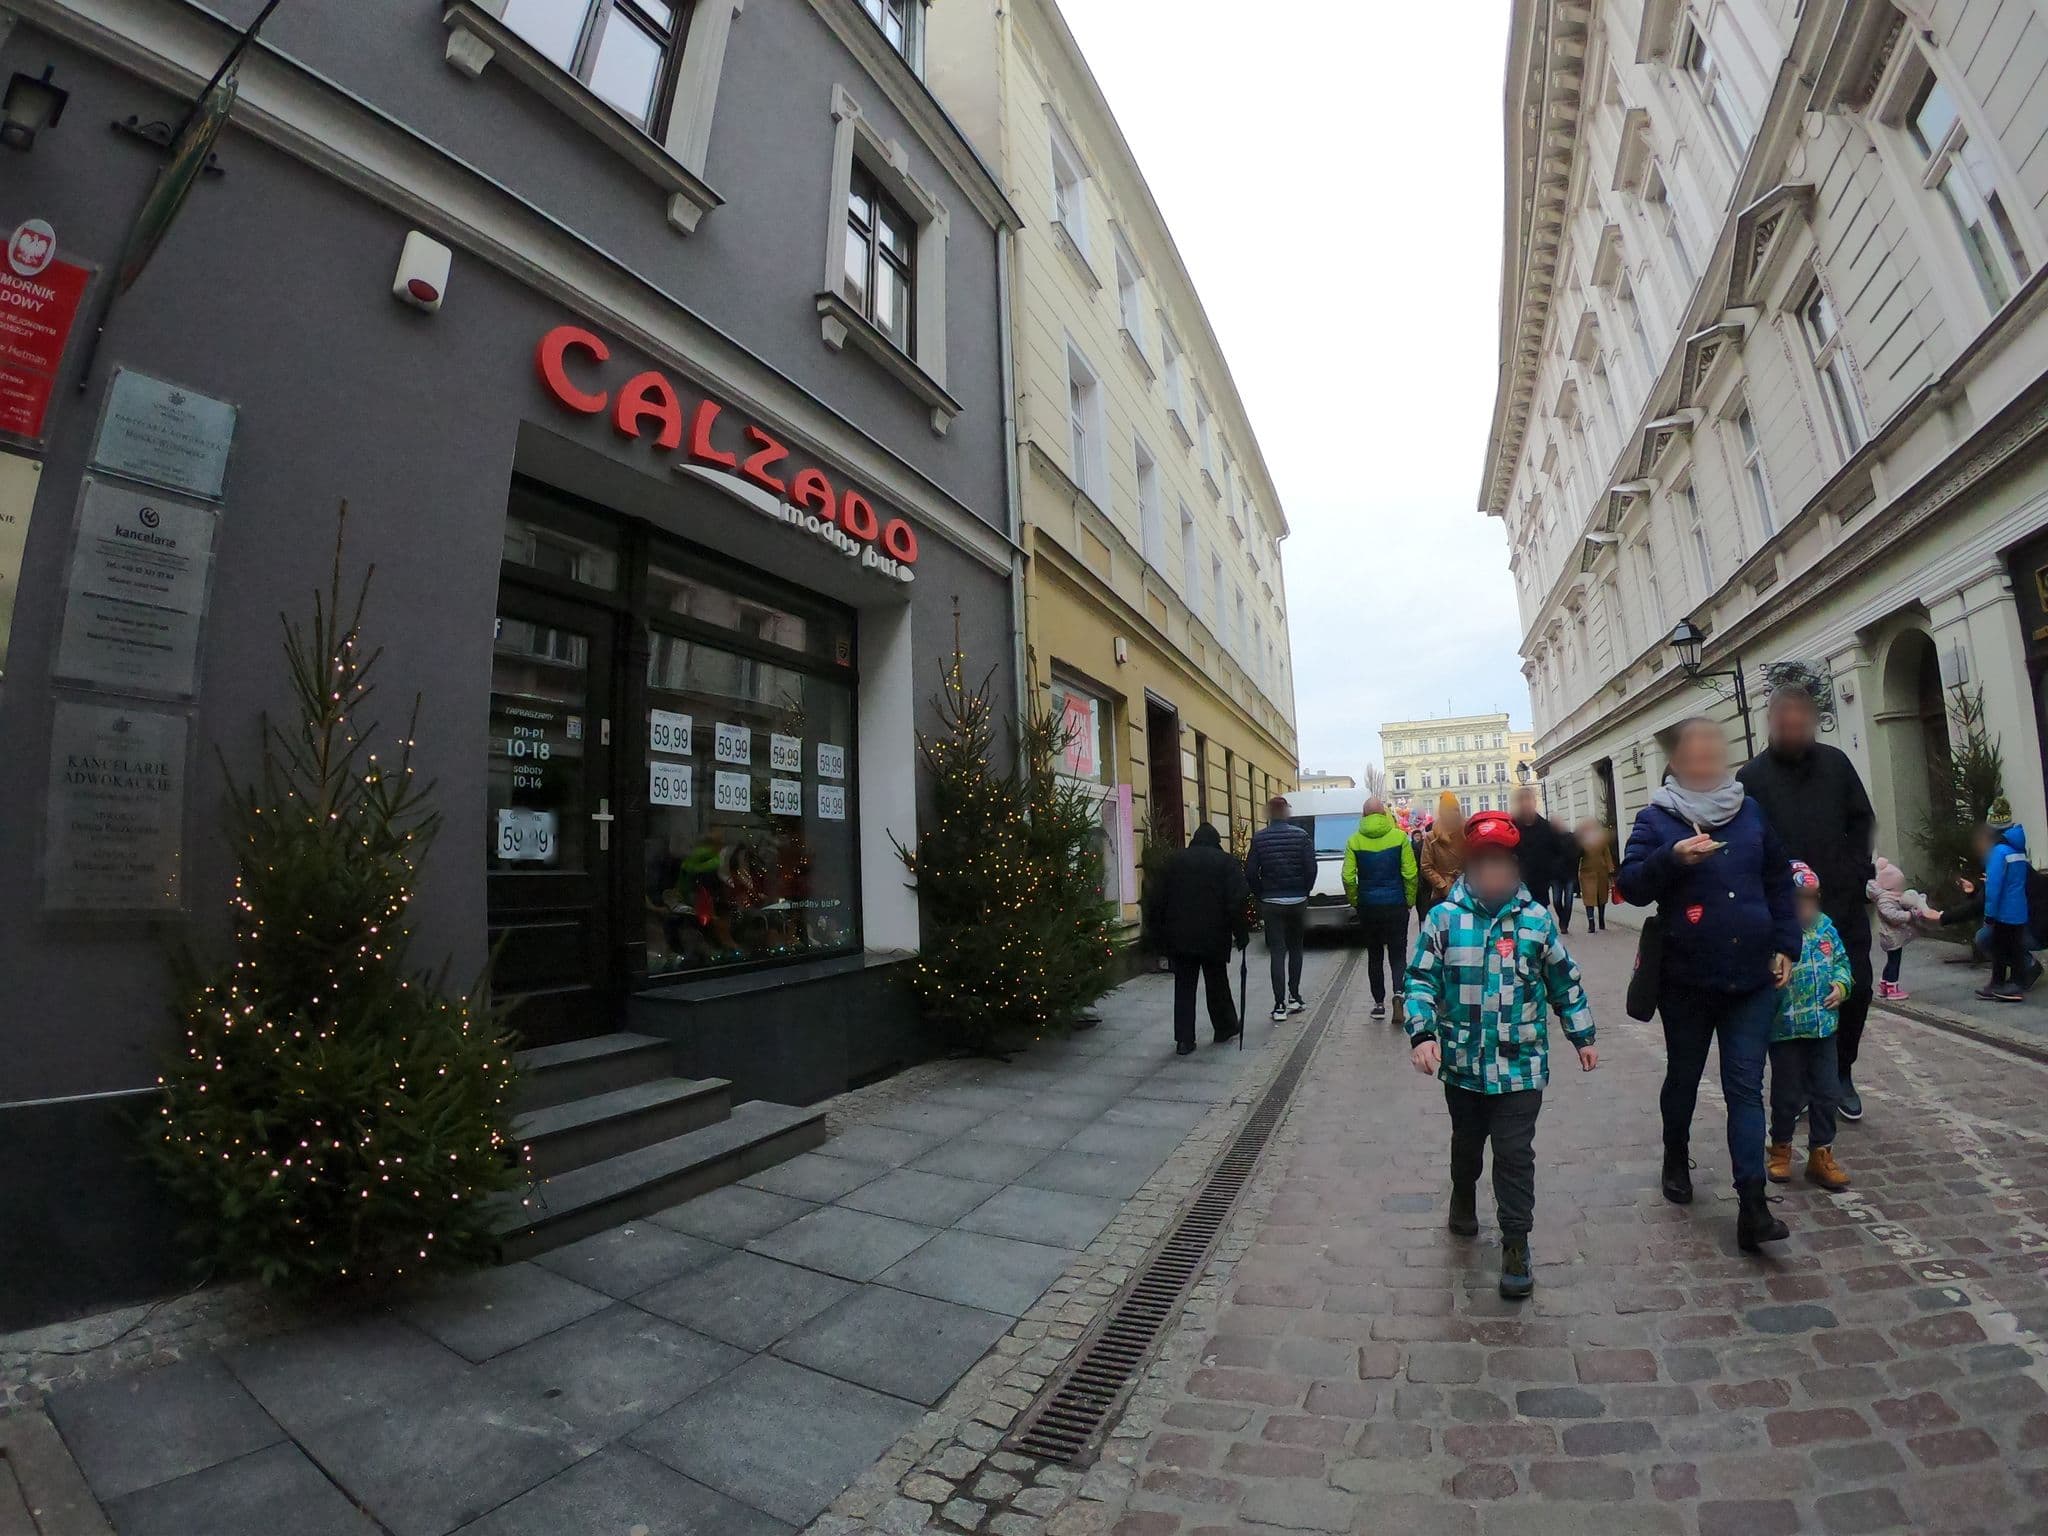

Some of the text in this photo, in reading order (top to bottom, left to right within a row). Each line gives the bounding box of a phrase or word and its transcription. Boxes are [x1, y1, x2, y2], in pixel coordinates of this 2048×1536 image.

[0, 272, 56, 301] MORNIK
[0, 290, 44, 312] DOWY
[536, 325, 918, 564] CALZADO
[115, 525, 176, 549] kancelarie
[780, 502, 860, 557] modny
[653, 724, 688, 750] 59,99
[718, 736, 748, 760] 59,99
[507, 739, 551, 760] 10-18
[773, 746, 799, 767] 59,99
[513, 776, 543, 789] 10-14
[653, 777, 688, 801] 59,99
[718, 784, 748, 806] 59,99
[773, 790, 799, 811] 59,99
